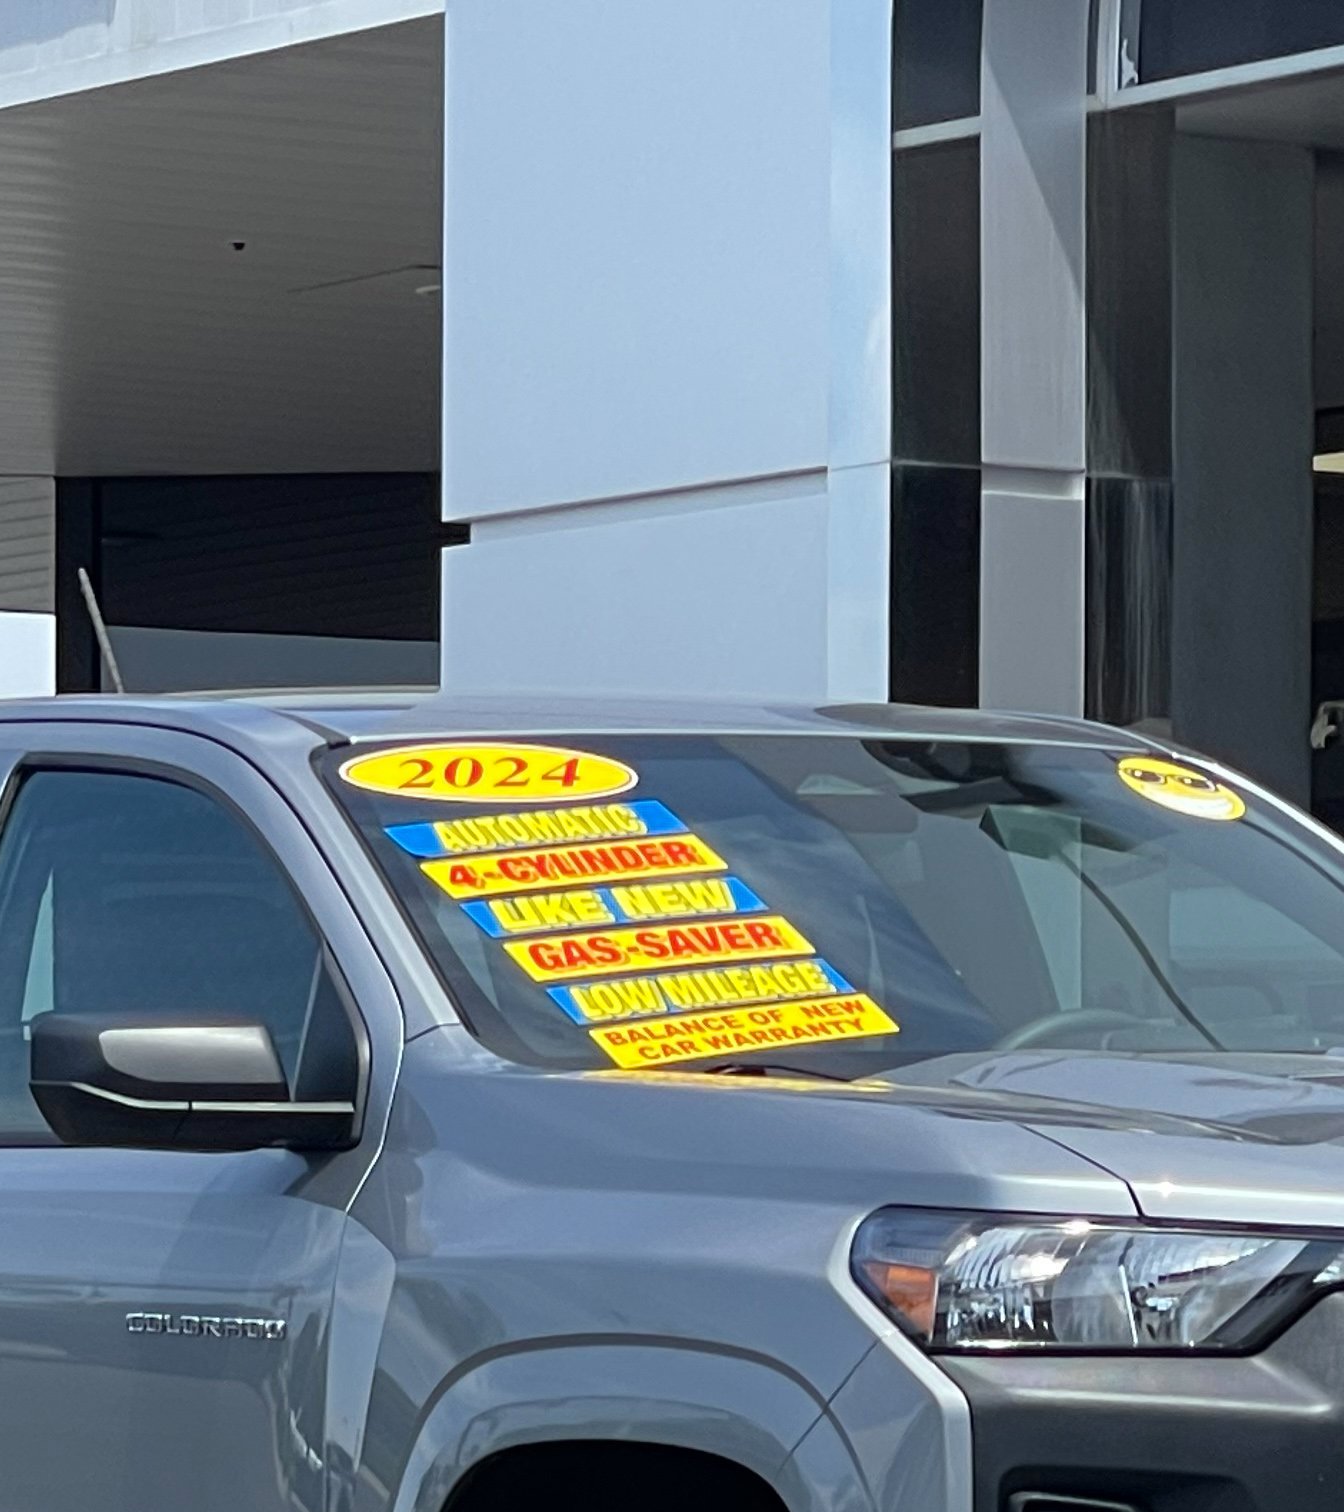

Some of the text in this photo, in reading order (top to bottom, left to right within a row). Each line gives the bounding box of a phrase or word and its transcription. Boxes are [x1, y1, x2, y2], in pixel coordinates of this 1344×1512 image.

[399, 757, 580, 789] 2024
[433, 804, 647, 853] AUTOMATIC
[449, 841, 706, 890] 4-CYLINDER
[489, 879, 736, 933] LIKE NEW
[528, 922, 786, 973] GAS-SAVER
[570, 957, 836, 1021] LOW MILEAGE
[604, 999, 866, 1047] BALANCE OF NEW
[638, 1017, 865, 1061] CAR WARRANTY
[126, 1313, 287, 1340] COLORADO
